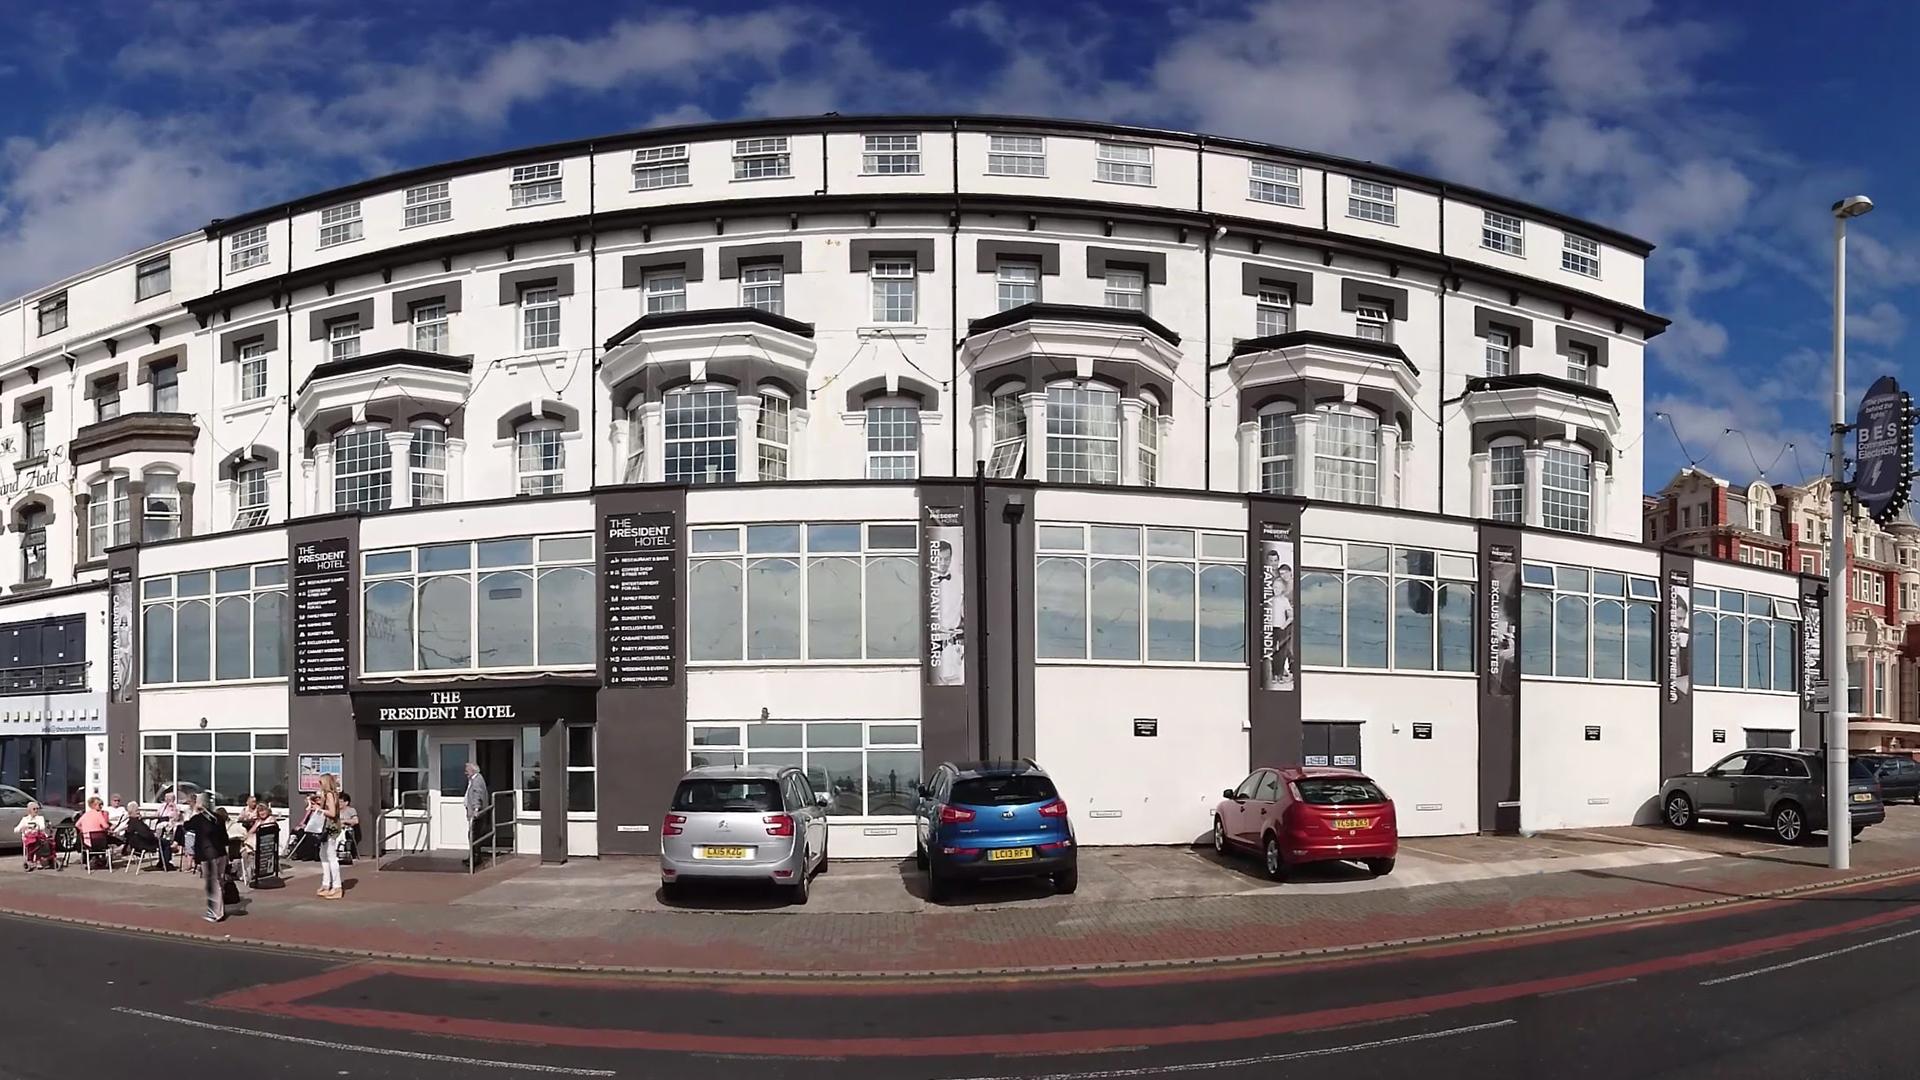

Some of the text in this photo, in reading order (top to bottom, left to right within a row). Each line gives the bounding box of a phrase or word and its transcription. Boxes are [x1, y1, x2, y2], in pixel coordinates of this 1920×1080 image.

[1858, 446, 1898, 459] Electricity
[610, 518, 631, 528] THE
[609, 526, 671, 538] PRESIDENT
[634, 536, 670, 547] HOTEL
[298, 545, 315, 555] THE
[298, 551, 346, 563] PRESIDENT
[317, 560, 345, 570] HOTEL
[930, 540, 941, 667] RESTAURANT & BARS
[1263, 565, 1274, 661] FAMILY FRIENDLY
[1491, 580, 1500, 675] EXCLUSIVE SUITES
[1670, 621, 1678, 648] SHOP
[113, 594, 121, 691] CABARET WEEKENDS
[431, 691, 462, 704] THE
[379, 705, 515, 720] PRESIDENT HOTEL
[995, 850, 1013, 858] LC13
